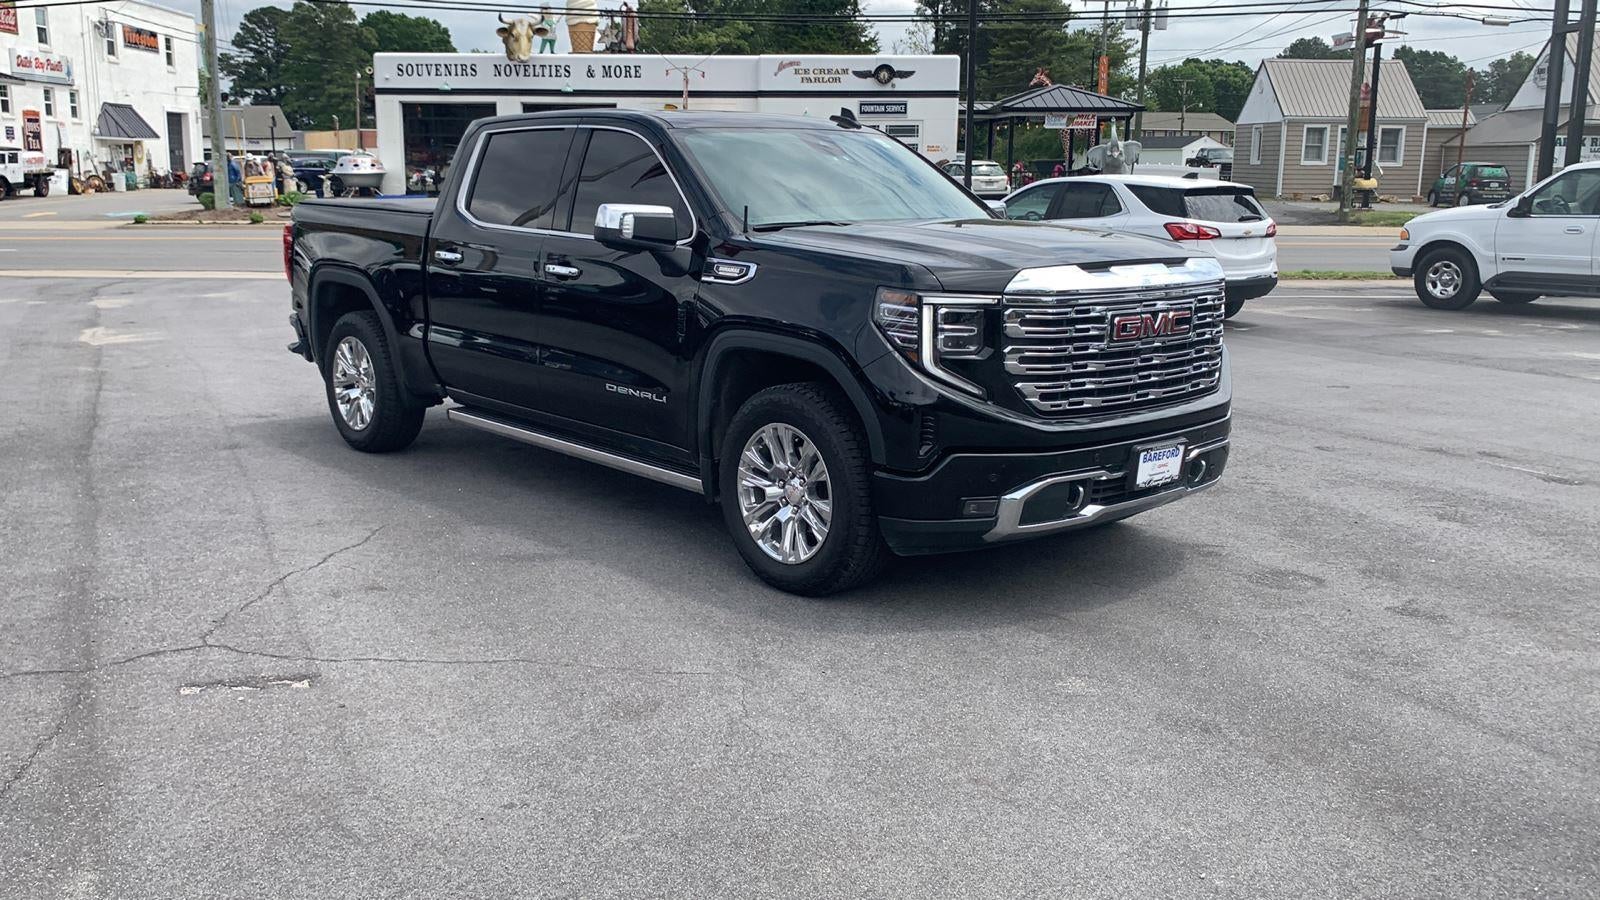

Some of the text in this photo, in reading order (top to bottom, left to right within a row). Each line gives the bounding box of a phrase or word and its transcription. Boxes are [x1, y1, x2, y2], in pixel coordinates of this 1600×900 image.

[123, 25, 157, 48] Firestone
[16, 54, 63, 73] Dutch Boy Paints
[397, 63, 642, 78] SOUVENIRS NOVELTIES & MORE
[794, 67, 810, 75] ICE
[812, 67, 849, 75] CREAM
[801, 76, 842, 84] PARLOR
[861, 105, 906, 113] FOUNTAIN SERVICE
[1114, 310, 1191, 340] GMC
[605, 383, 667, 403] DENALI
[1142, 446, 1181, 464] BAREFORD
